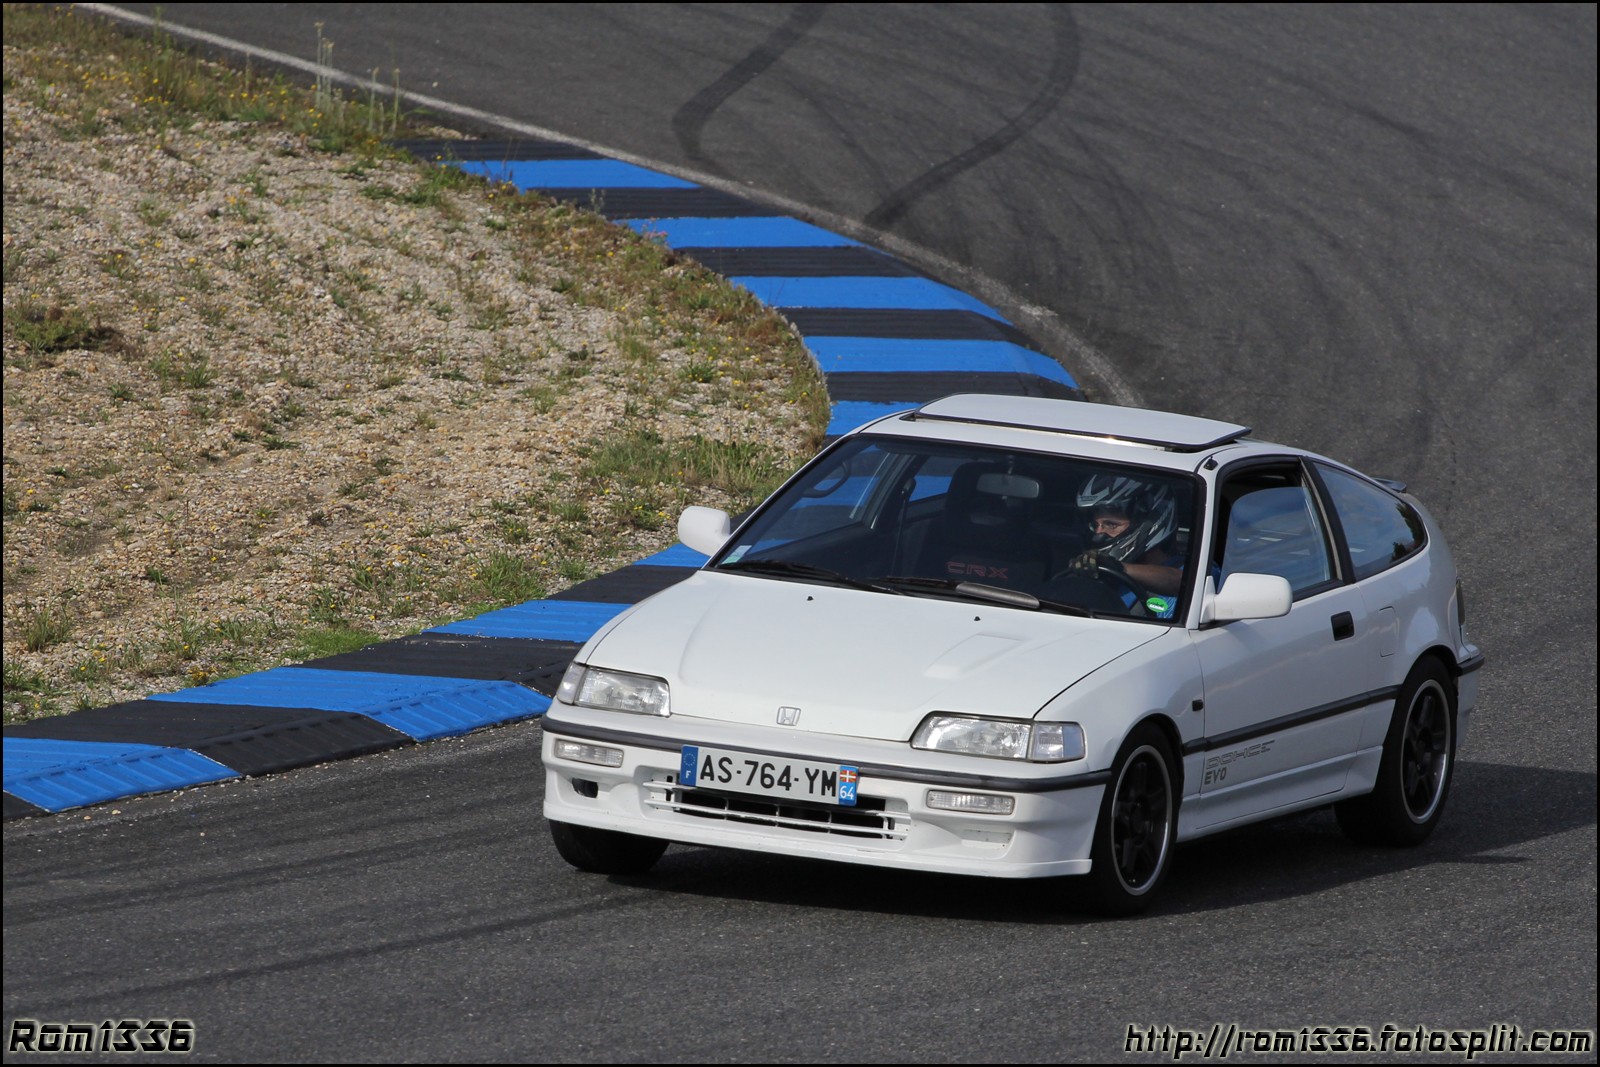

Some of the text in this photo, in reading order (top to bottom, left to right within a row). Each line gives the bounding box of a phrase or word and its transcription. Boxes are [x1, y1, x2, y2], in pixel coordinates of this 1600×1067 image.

[946, 561, 1009, 579] CRX
[685, 770, 692, 779] F
[700, 755, 837, 797] AS-764-YM
[1204, 767, 1227, 785] EVO
[840, 786, 855, 800] 64
